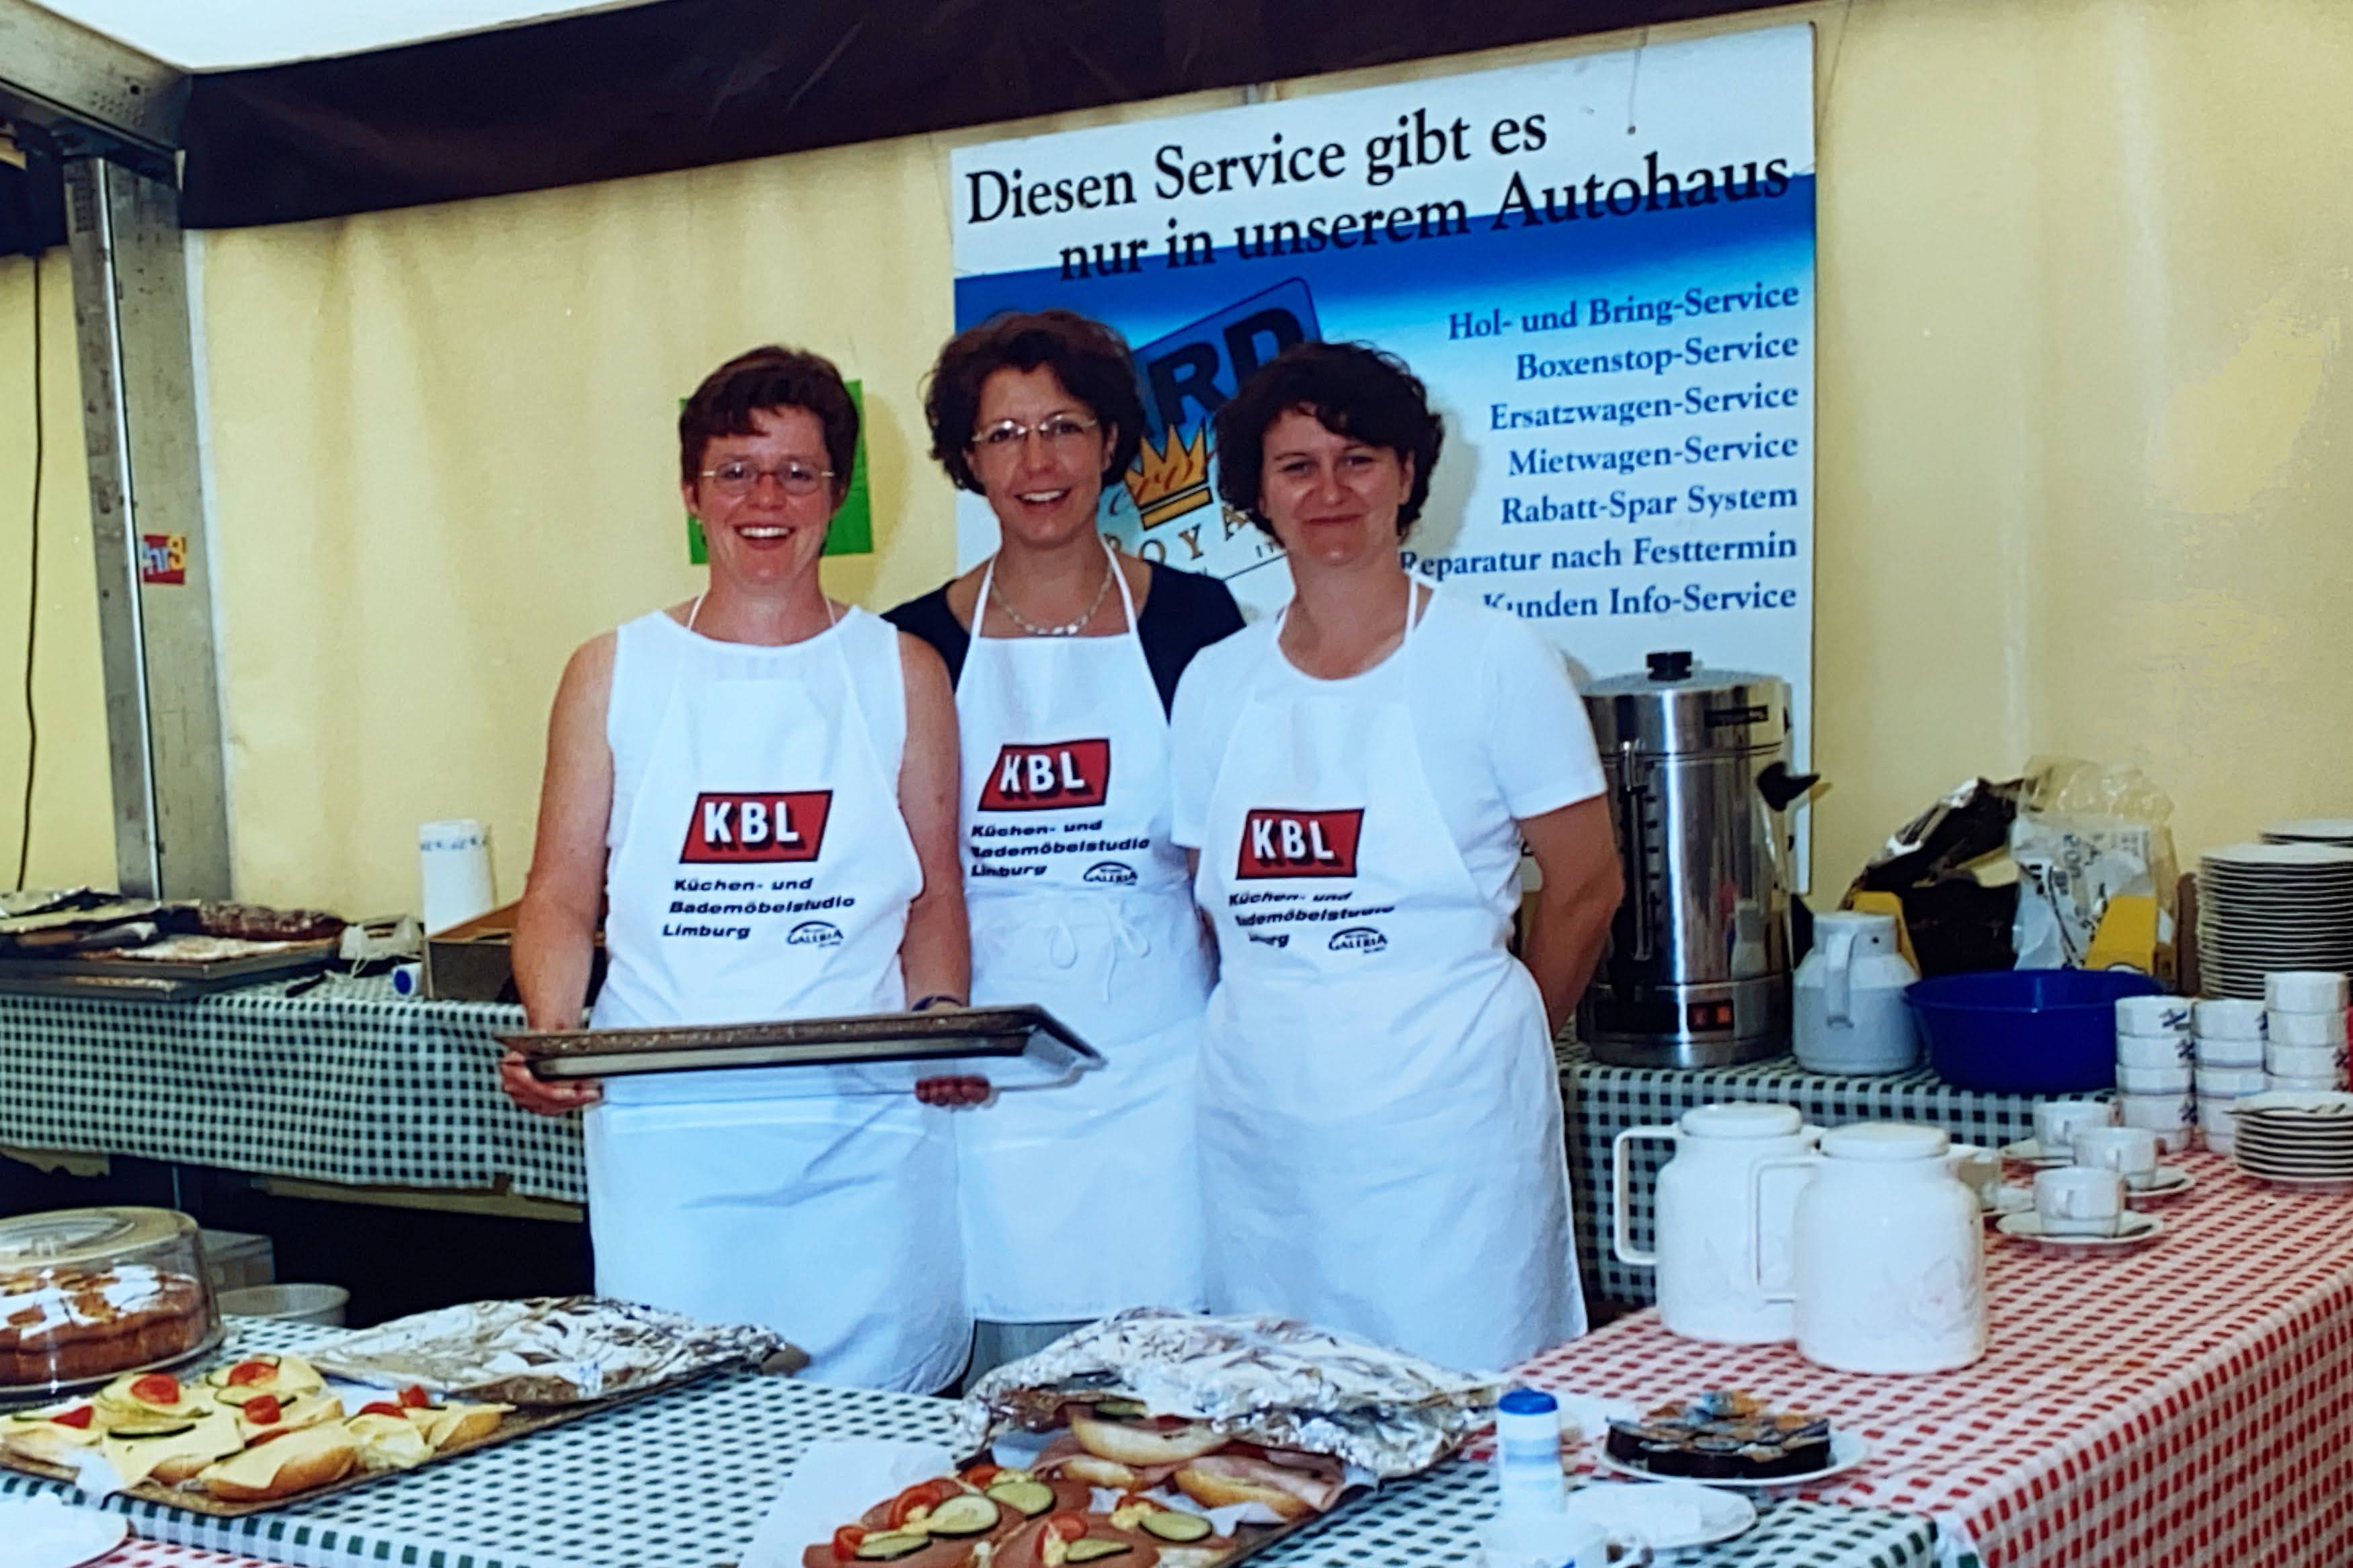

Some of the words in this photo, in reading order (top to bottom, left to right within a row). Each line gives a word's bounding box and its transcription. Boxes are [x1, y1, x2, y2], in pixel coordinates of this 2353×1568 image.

[965, 169, 1137, 224] Diesen
[1155, 132, 1346, 199] Service
[1366, 108, 1471, 185] gibt
[1491, 113, 1547, 155] es
[1060, 236, 1148, 280] nur
[1165, 217, 1215, 269] in
[1234, 198, 1471, 260] unserem
[1491, 151, 1790, 230] Autohaus
[1448, 307, 1513, 340] Hol-
[1521, 300, 1577, 332] und
[1588, 282, 1800, 326] Bring-Service
[1143, 307, 1306, 437] RD
[1516, 332, 1799, 381] Boxenstop-Service
[1490, 382, 1799, 431] Ersatzwagen-Service
[1508, 431, 1799, 477] Mietwagen-Service
[1501, 489, 1677, 526] Rabatt-Spar
[1687, 484, 1798, 518] System
[1551, 537, 1622, 570] nach
[1633, 531, 1798, 566] Festtermin
[1609, 581, 1797, 616] Info-Service
[1000, 751, 1086, 794] KBL
[704, 801, 801, 845] KBL
[971, 824, 1055, 837] Küchen-
[1064, 819, 1103, 833] und
[1252, 819, 1335, 861] KBL
[668, 895, 856, 914] Bademöbelstudio
[674, 877, 763, 891] Küchen-
[772, 877, 813, 891] und
[1313, 891, 1353, 903] und
[662, 923, 751, 940] Limburg
